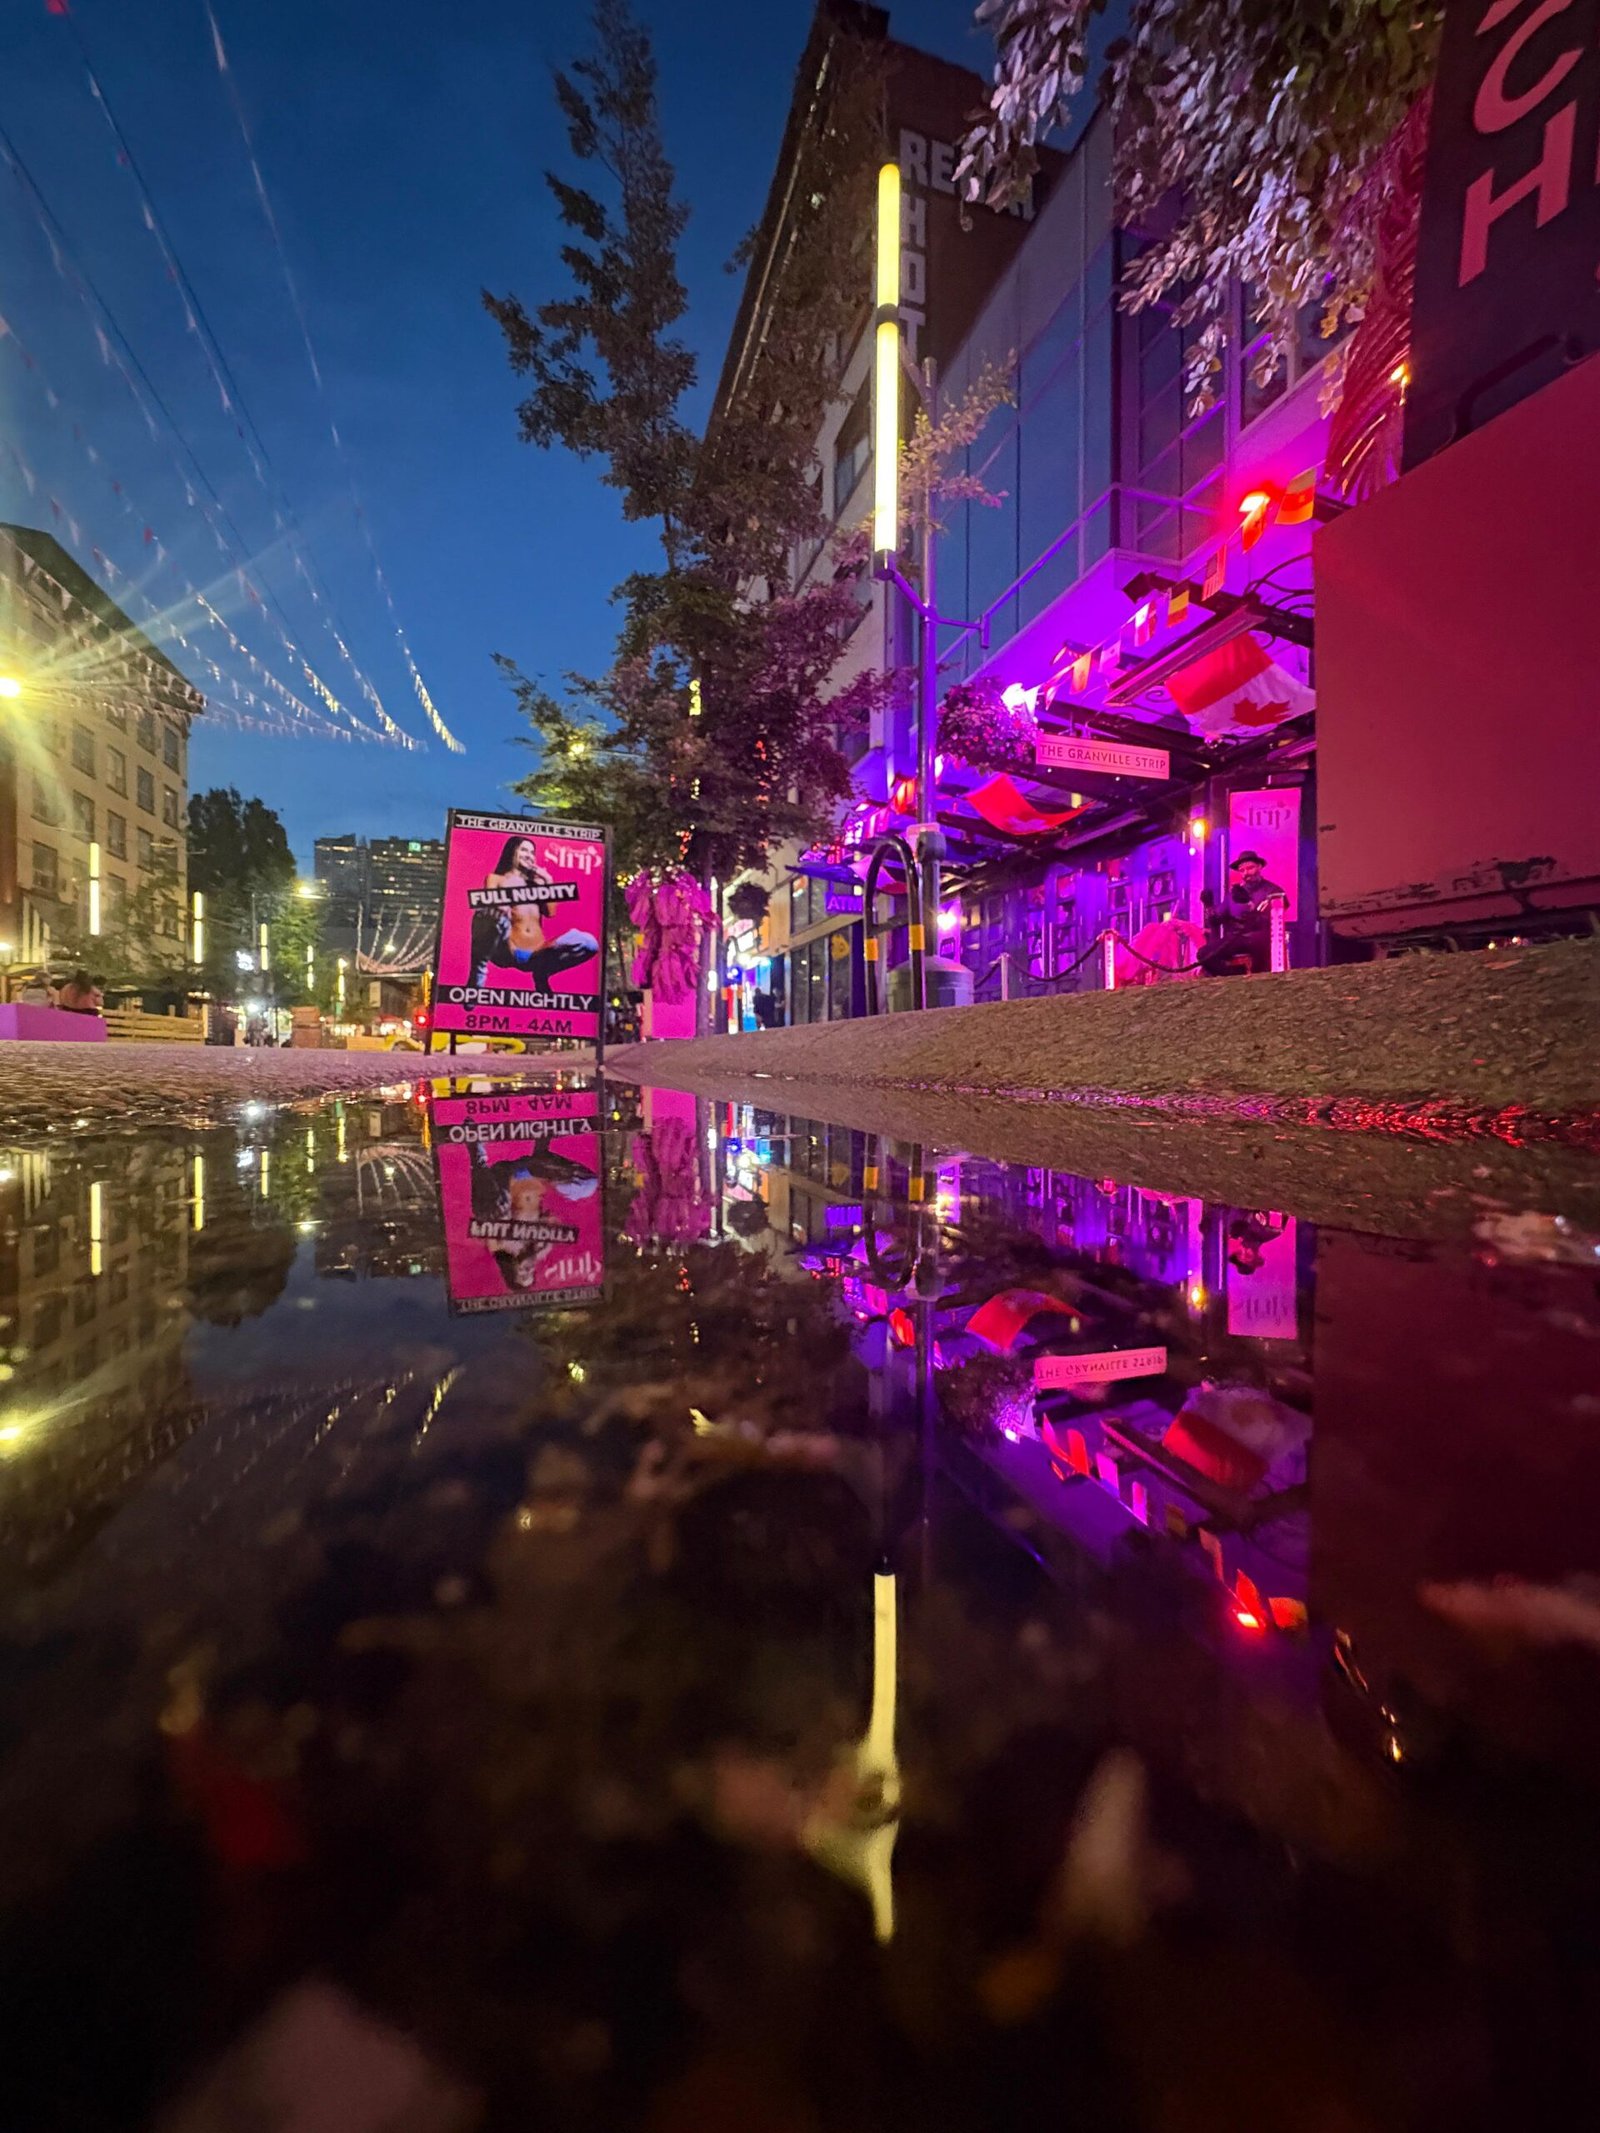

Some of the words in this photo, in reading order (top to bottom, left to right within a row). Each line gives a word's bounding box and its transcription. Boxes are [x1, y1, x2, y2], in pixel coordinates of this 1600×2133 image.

[1040, 744, 1063, 758] THE
[1068, 748, 1131, 766] GRANVILLE
[1135, 757, 1166, 770] STRIP
[460, 816, 485, 828] THE
[489, 819, 561, 836] GRANVILLE
[565, 828, 600, 840] STRIP
[470, 889, 511, 906] FULL
[512, 884, 576, 902] NUDITY
[449, 987, 505, 1006] OPEN
[510, 991, 593, 1010] NIGHTLY
[465, 1014, 510, 1030] 8PM
[527, 1018, 572, 1034] 4AM
